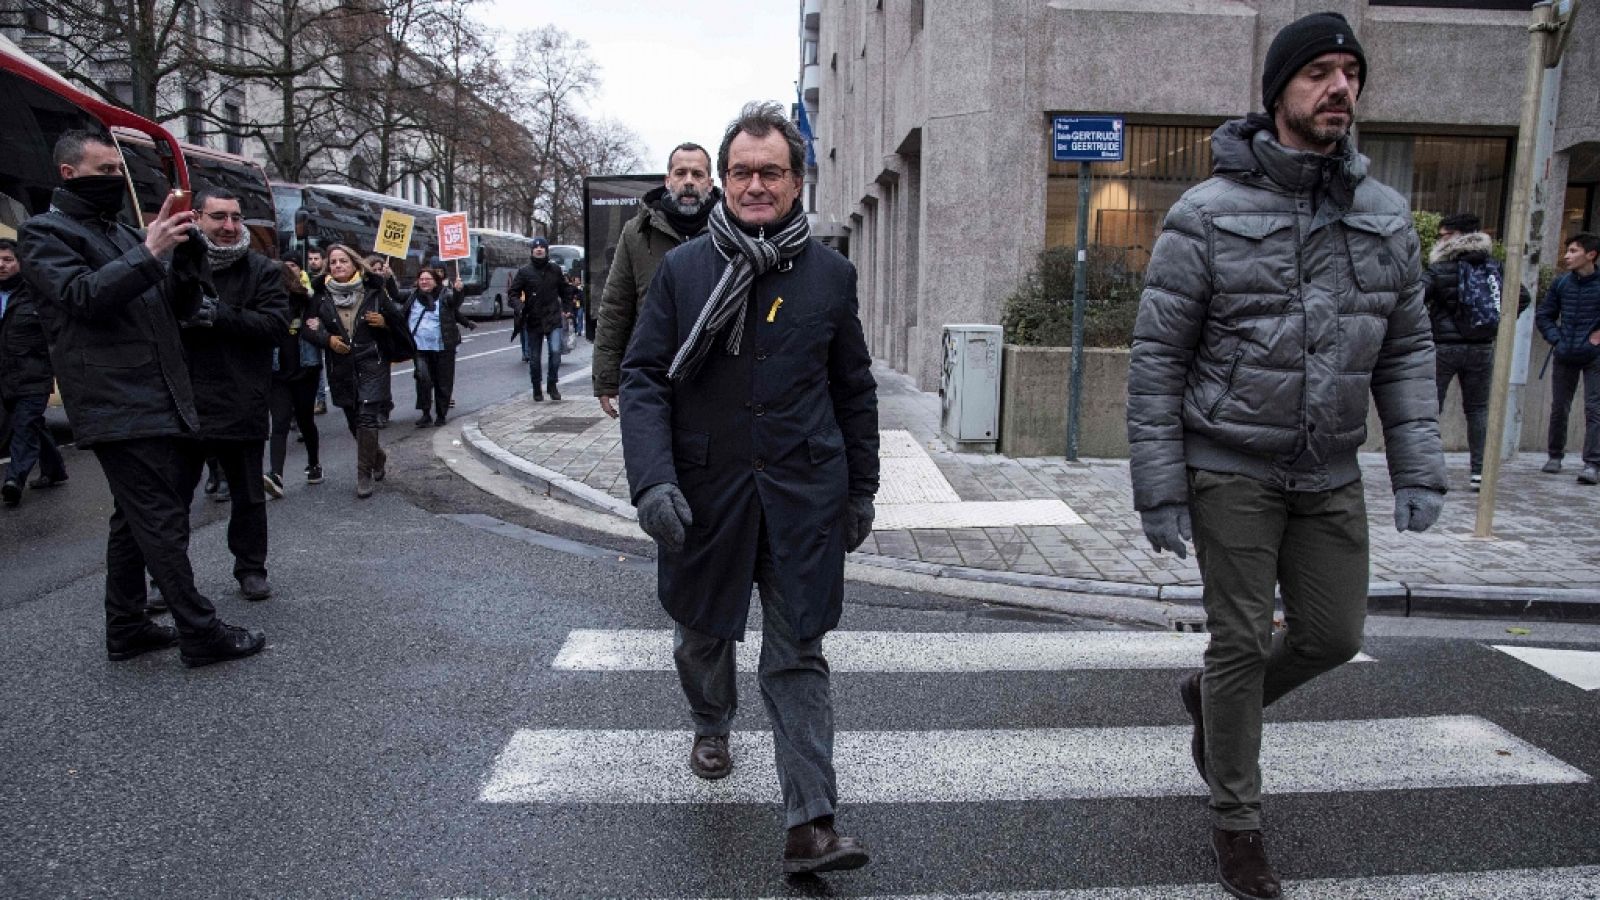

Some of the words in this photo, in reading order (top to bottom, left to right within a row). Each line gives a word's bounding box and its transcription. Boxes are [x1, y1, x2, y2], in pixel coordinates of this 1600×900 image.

[1071, 130, 1120, 141] GERTRUDE
[1071, 141, 1120, 151] GEERTRUIDE
[383, 229, 405, 243] UP!
